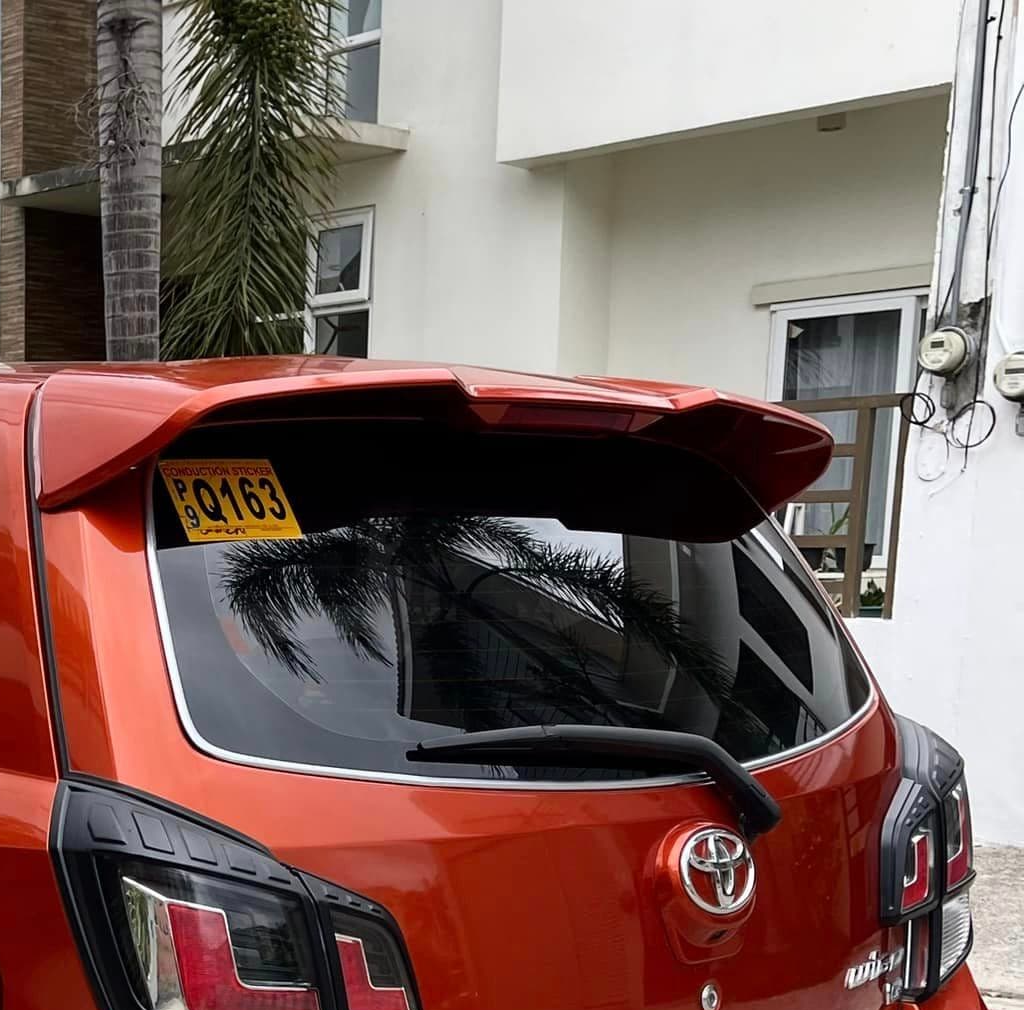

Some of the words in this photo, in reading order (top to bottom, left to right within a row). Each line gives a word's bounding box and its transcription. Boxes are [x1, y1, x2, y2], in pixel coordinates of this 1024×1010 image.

[163, 467, 230, 477] CONDUCTION
[233, 466, 273, 476] STICKER
[192, 477, 286, 524] Q163
